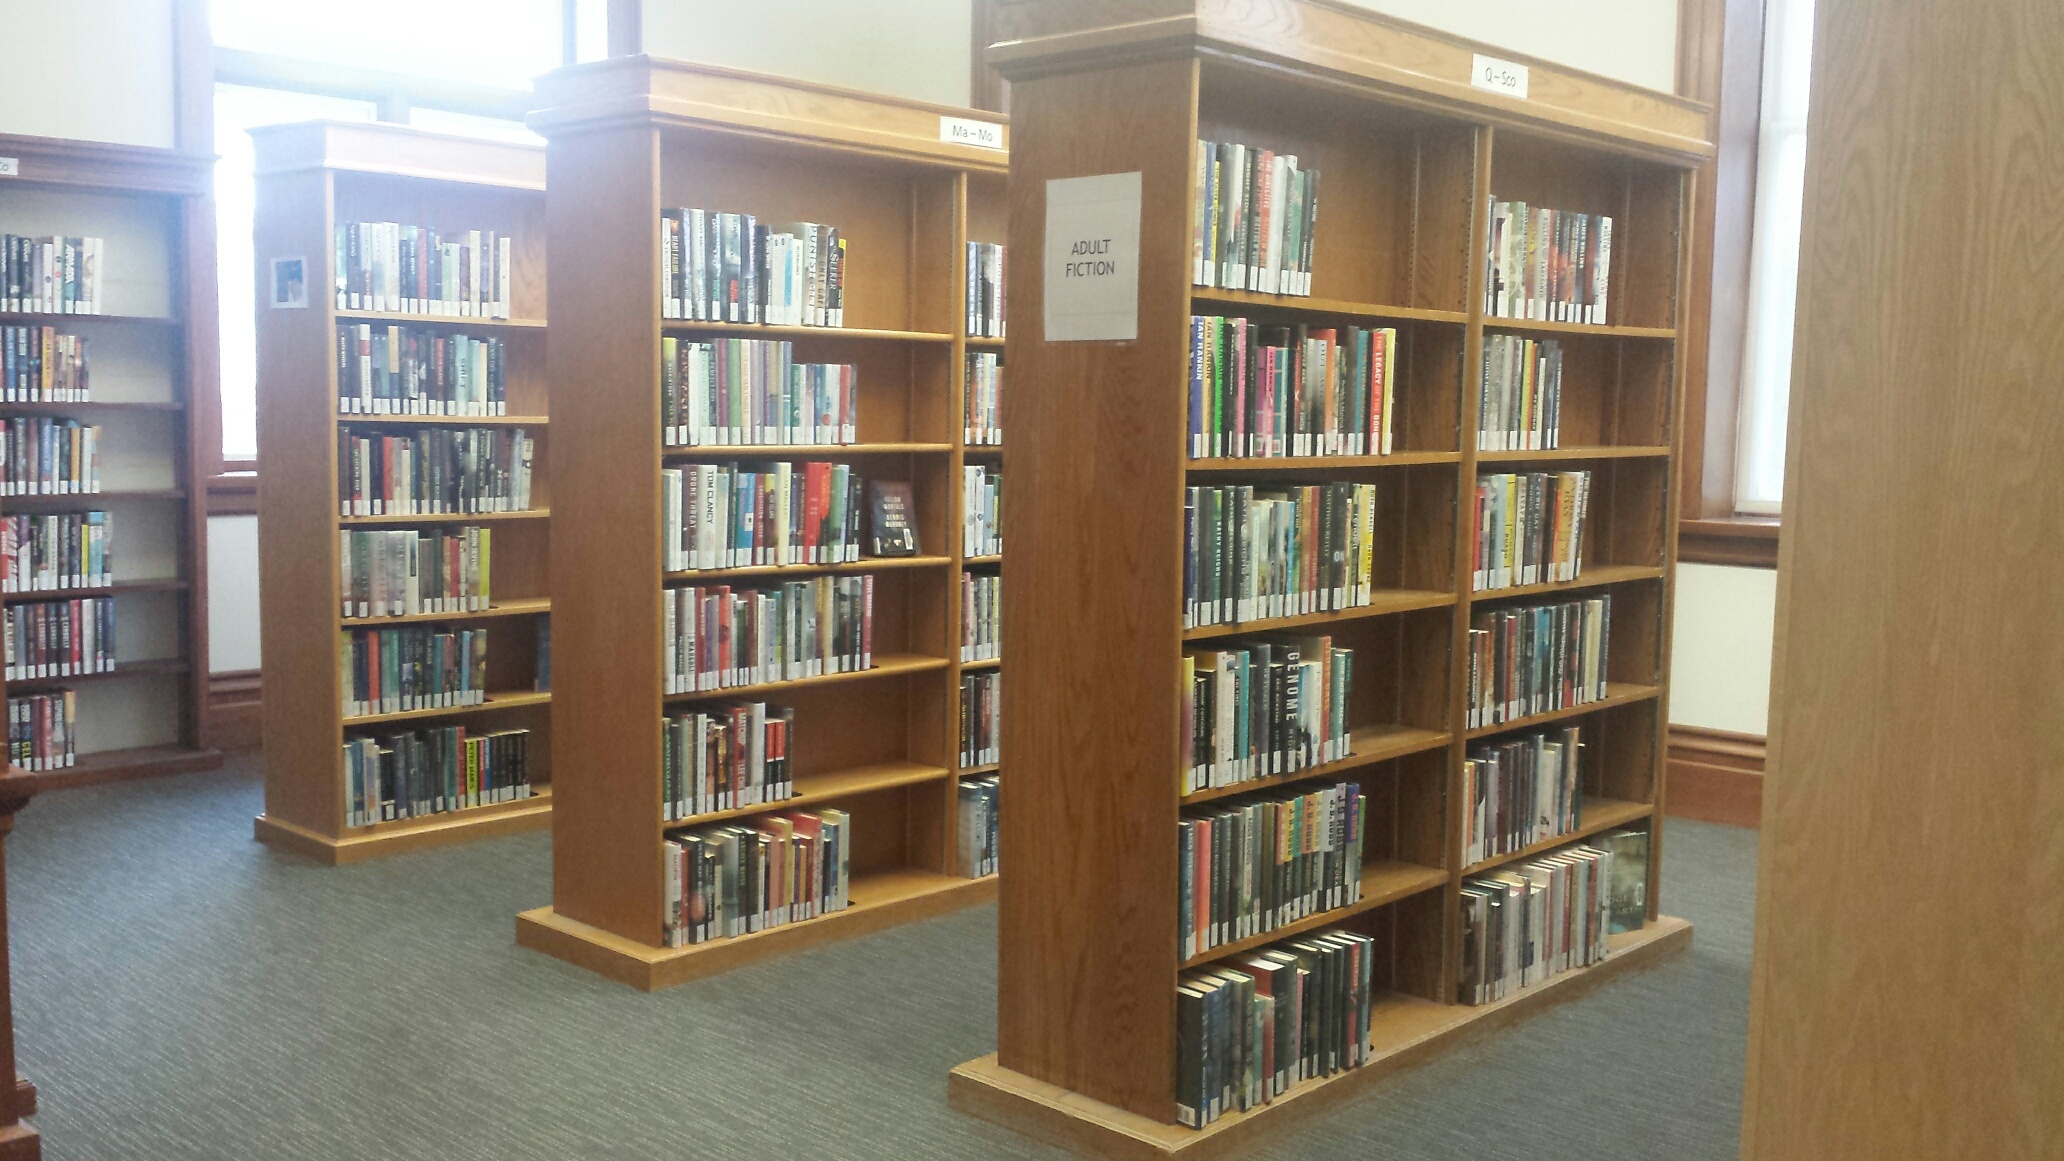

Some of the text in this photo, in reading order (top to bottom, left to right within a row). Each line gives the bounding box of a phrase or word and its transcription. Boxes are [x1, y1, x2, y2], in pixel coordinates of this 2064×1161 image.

[952, 125, 993, 142] Ma Mo
[671, 235, 679, 253] HEART
[1071, 239, 1112, 256] ADULT
[830, 253, 839, 290] SEEKER
[1065, 261, 1115, 278] FICTION
[1286, 652, 1299, 721] GENOME
[738, 712, 746, 745] MATCHUP
